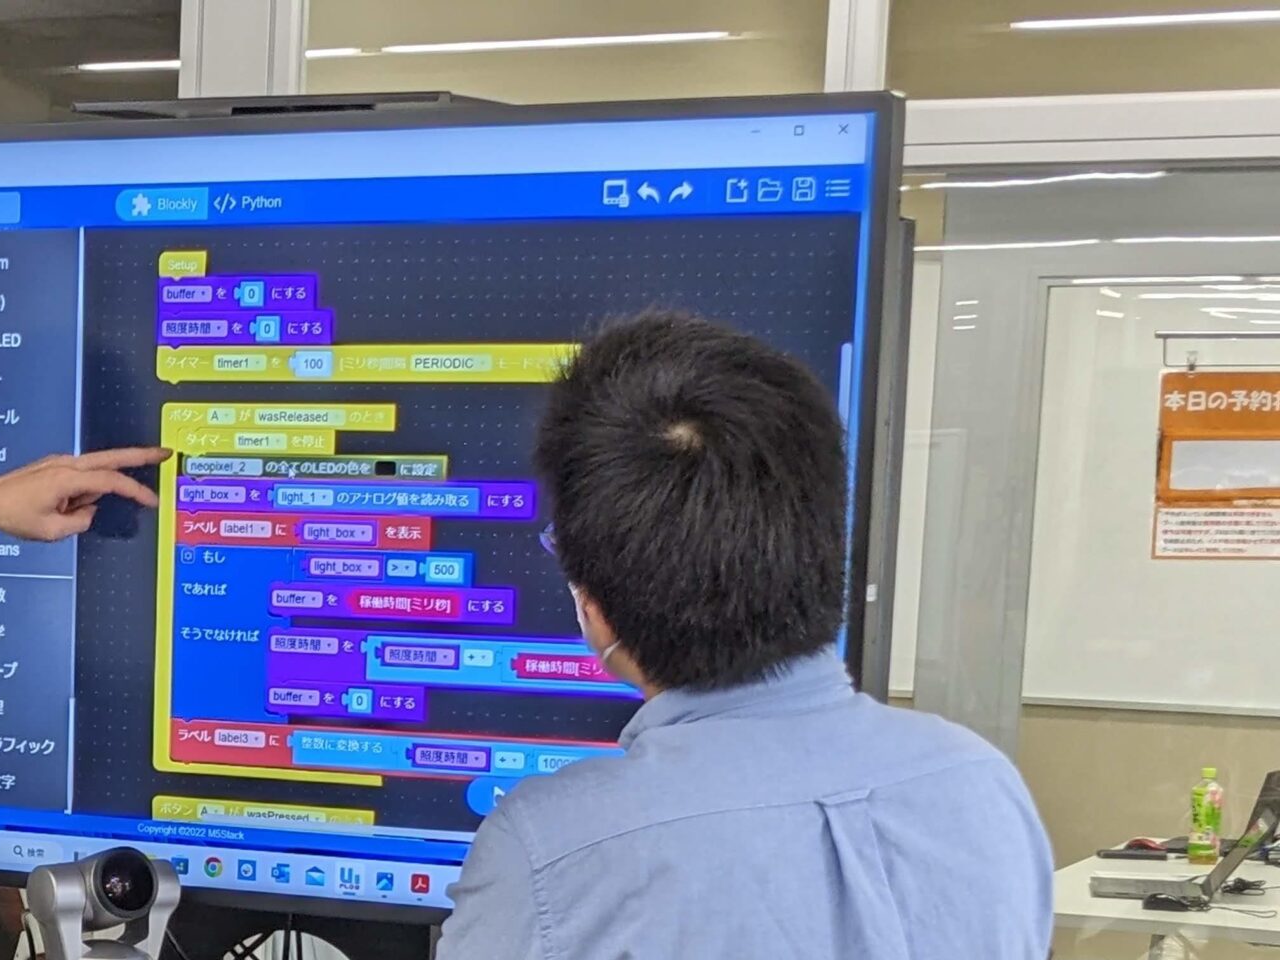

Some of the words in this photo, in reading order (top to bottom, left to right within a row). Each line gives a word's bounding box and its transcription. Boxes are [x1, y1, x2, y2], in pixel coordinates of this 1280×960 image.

[158, 197, 197, 212] Blockly
[242, 195, 281, 210] Python
[167, 260, 198, 272] Setup
[166, 289, 195, 300] buffer
[216, 288, 227, 300] を
[272, 287, 306, 300] にする
[231, 322, 243, 335] を
[287, 322, 322, 335] にする
[165, 357, 208, 368] タイマー
[217, 357, 249, 368] timer1
[303, 359, 323, 370] 100
[414, 358, 474, 368] PERIODIC
[169, 409, 203, 422] ボタン
[211, 411, 218, 421] A
[240, 410, 251, 422] が
[258, 411, 328, 422] wasReleased
[186, 434, 229, 446] タイマー
[238, 436, 269, 446] timer1
[190, 461, 246, 473] neopixel_2
[183, 487, 229, 501] light_box
[250, 489, 260, 501] を
[282, 490, 316, 503] light_1
[337, 492, 469, 507] のアナログ値を読み取る
[487, 495, 524, 508] にする
[183, 521, 217, 534] ラベル
[224, 522, 253, 534] label1
[275, 524, 286, 536] に
[308, 526, 355, 539] light_box
[385, 526, 422, 540] を表示
[203, 551, 225, 563] もし
[314, 560, 362, 573] light_box
[434, 564, 454, 576] 500
[182, 583, 227, 596] であれば
[276, 593, 306, 604] buffer
[326, 594, 337, 606] を
[468, 600, 504, 613] にする
[180, 627, 260, 642] そうでなければ
[342, 640, 354, 652] を
[273, 691, 303, 703] buffer
[323, 692, 335, 704] を
[380, 696, 415, 709] にする
[178, 729, 211, 742] ラベル
[218, 731, 249, 744] label3
[269, 734, 280, 746] に
[160, 802, 193, 816] ボタン
[137, 823, 177, 836] Copyright
[178, 827, 206, 837] ©2022
[207, 829, 245, 841] M5Stack
